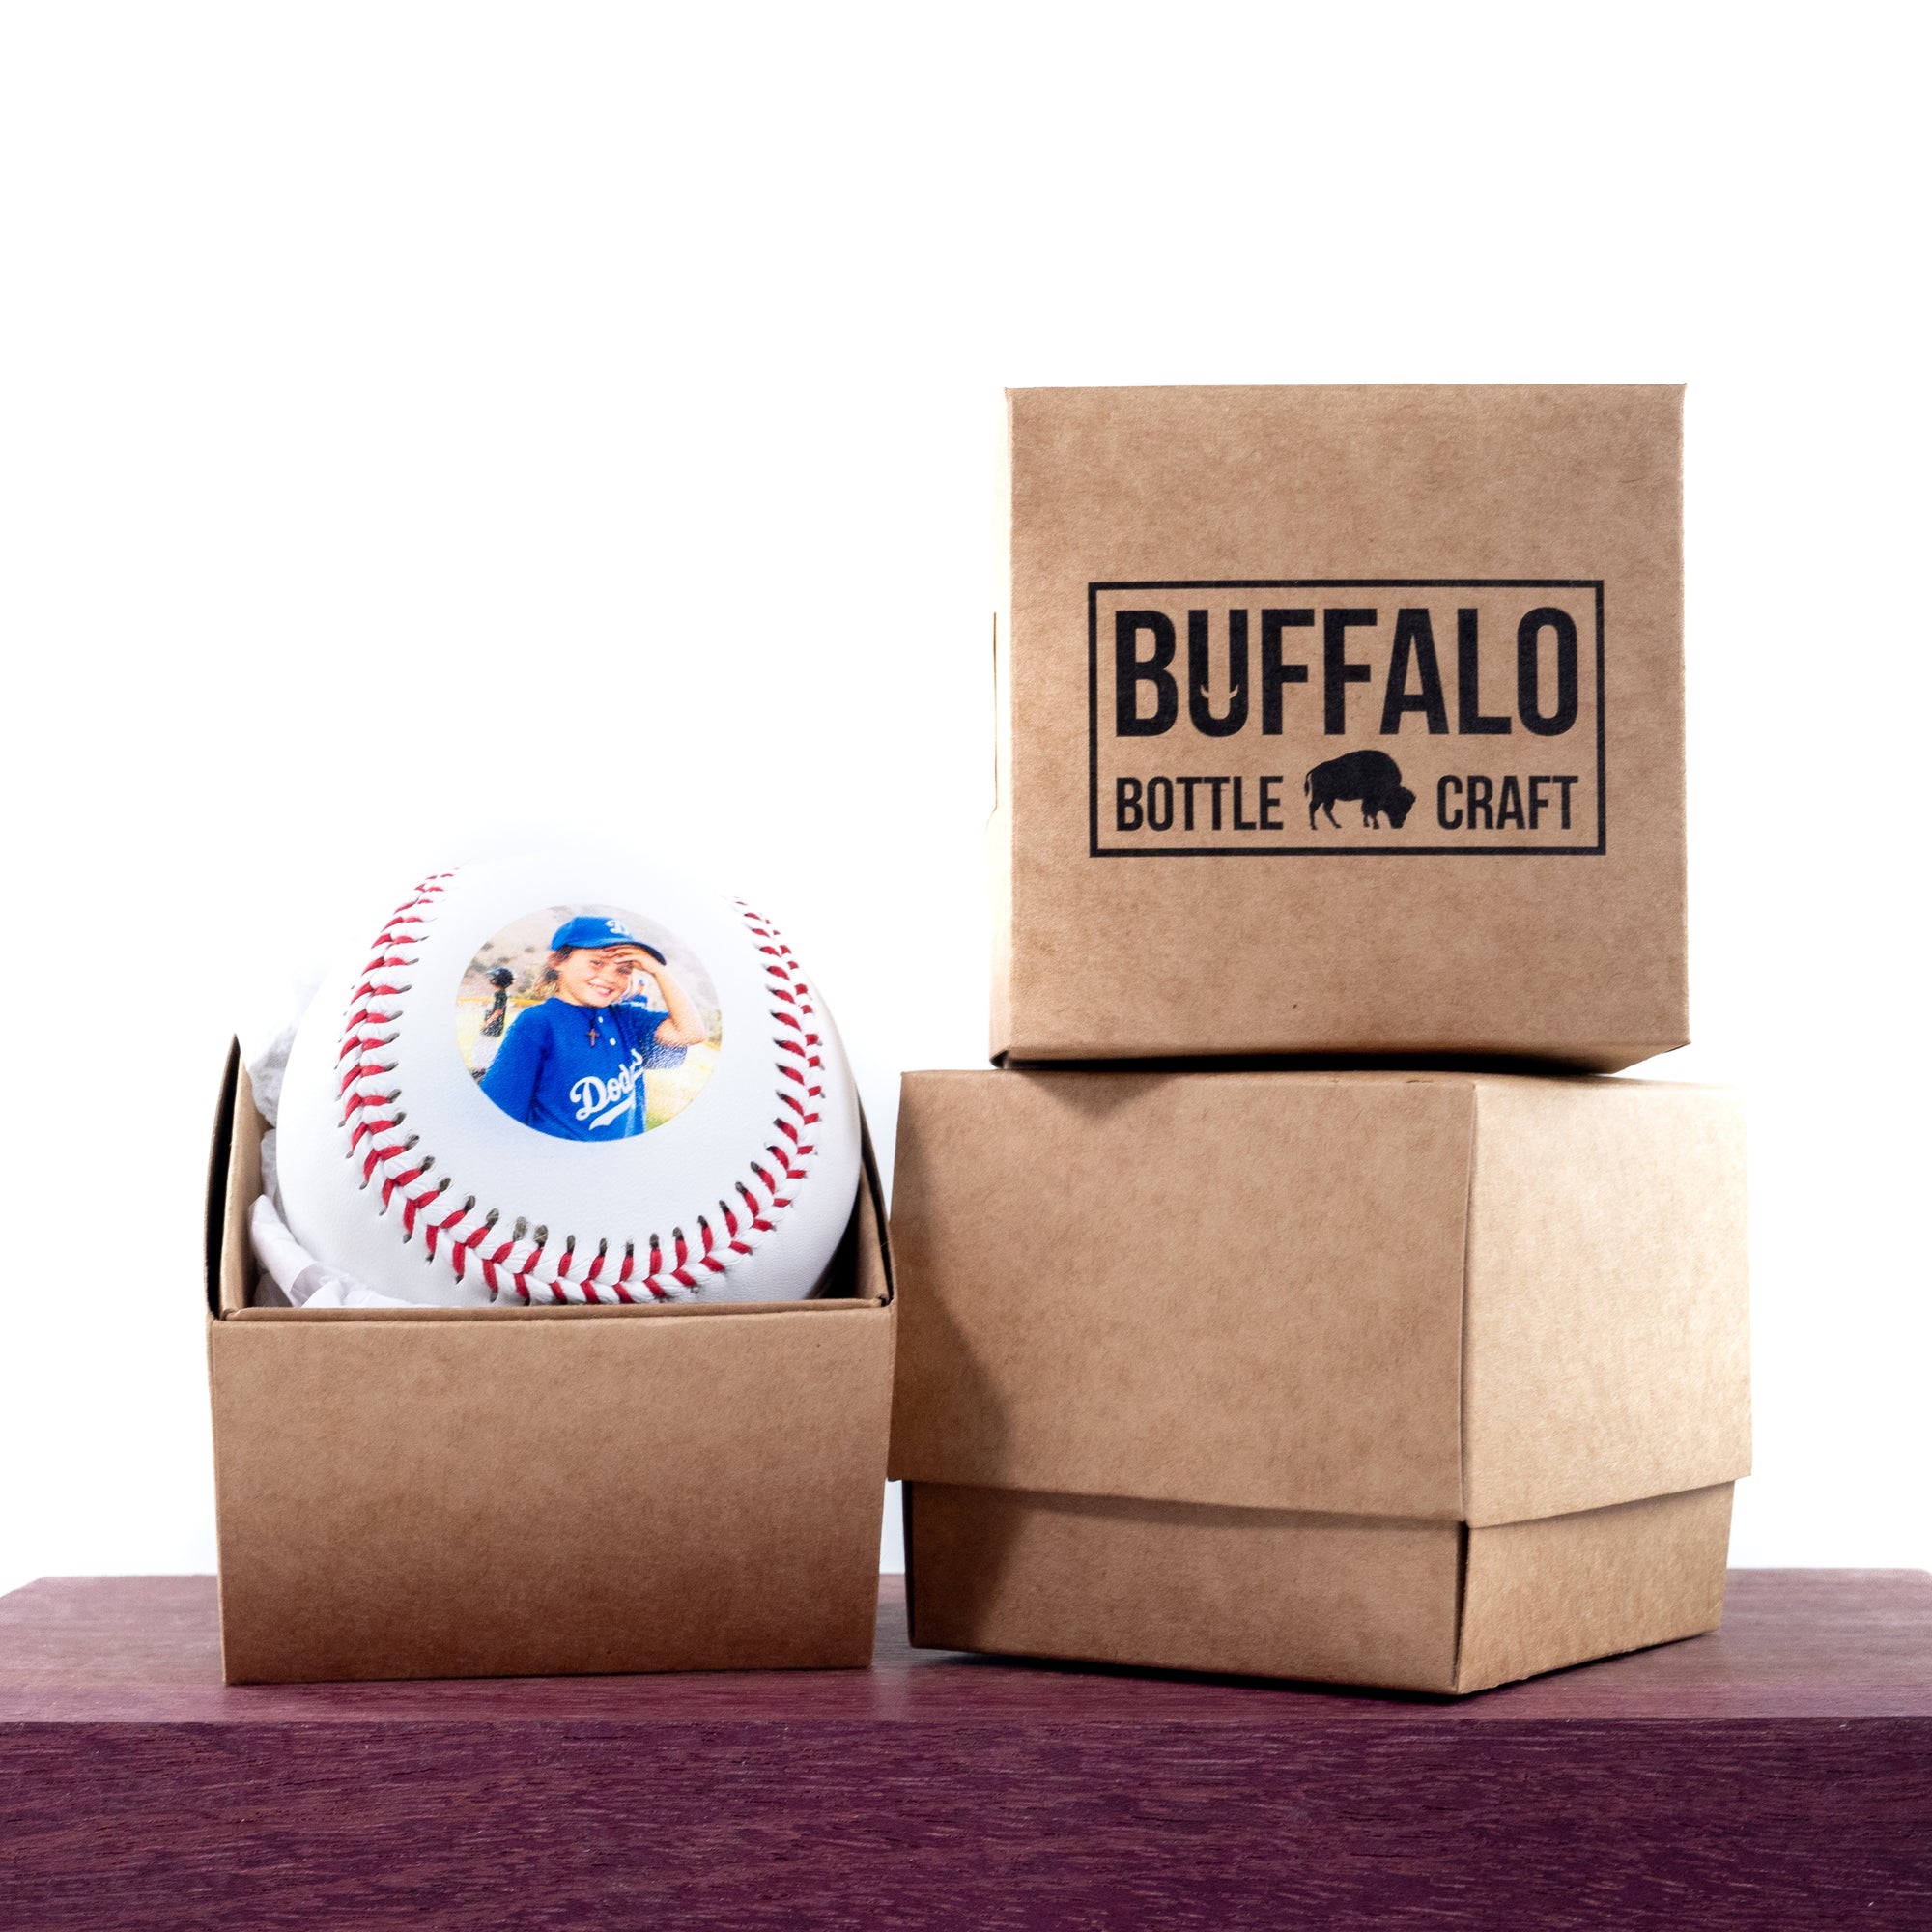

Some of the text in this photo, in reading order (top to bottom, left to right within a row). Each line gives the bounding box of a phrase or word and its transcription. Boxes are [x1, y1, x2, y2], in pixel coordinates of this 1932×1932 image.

[1115, 606, 1579, 738] BUFFALO
[1116, 774, 1579, 832] BOTTLE CRAFT
